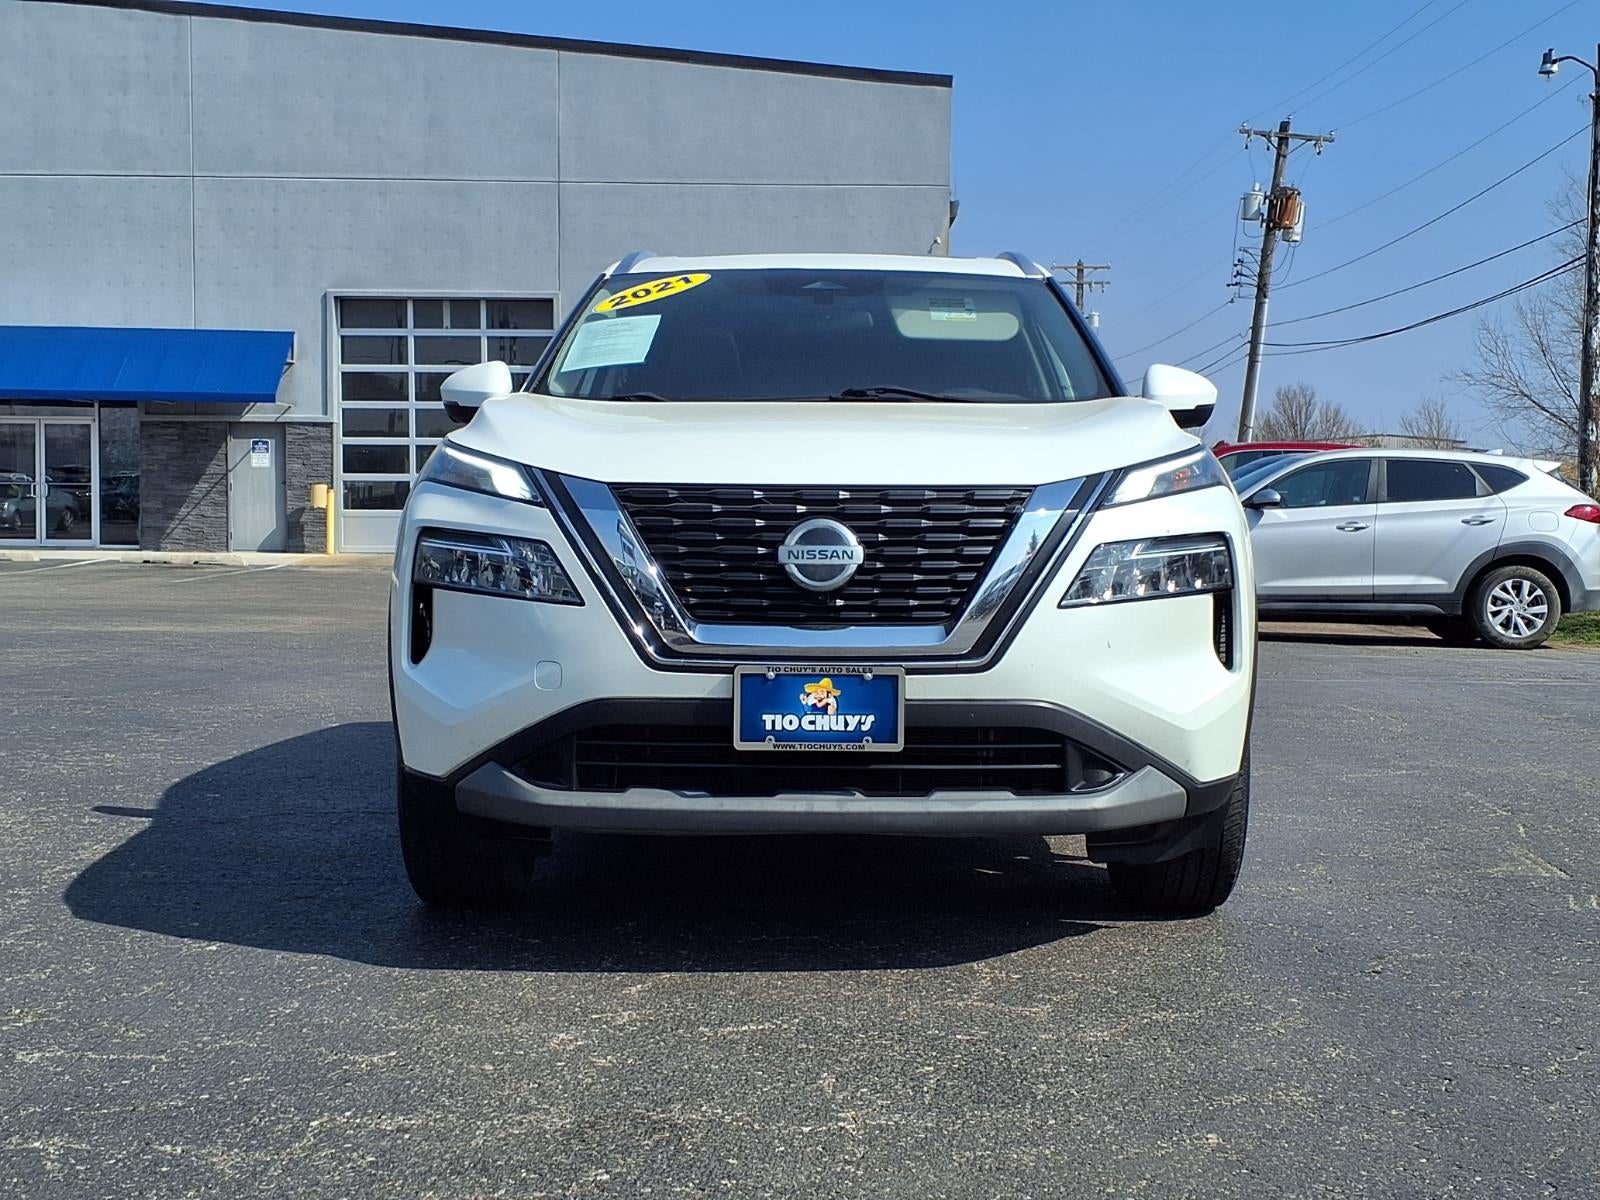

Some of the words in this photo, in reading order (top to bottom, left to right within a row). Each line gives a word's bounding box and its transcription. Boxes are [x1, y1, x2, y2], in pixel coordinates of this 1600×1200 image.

[608, 276, 693, 308] 2021
[787, 549, 854, 560] NISSAN
[762, 714, 799, 731] TIO
[772, 743, 866, 751] WWW.TIOCHUYS.COM
